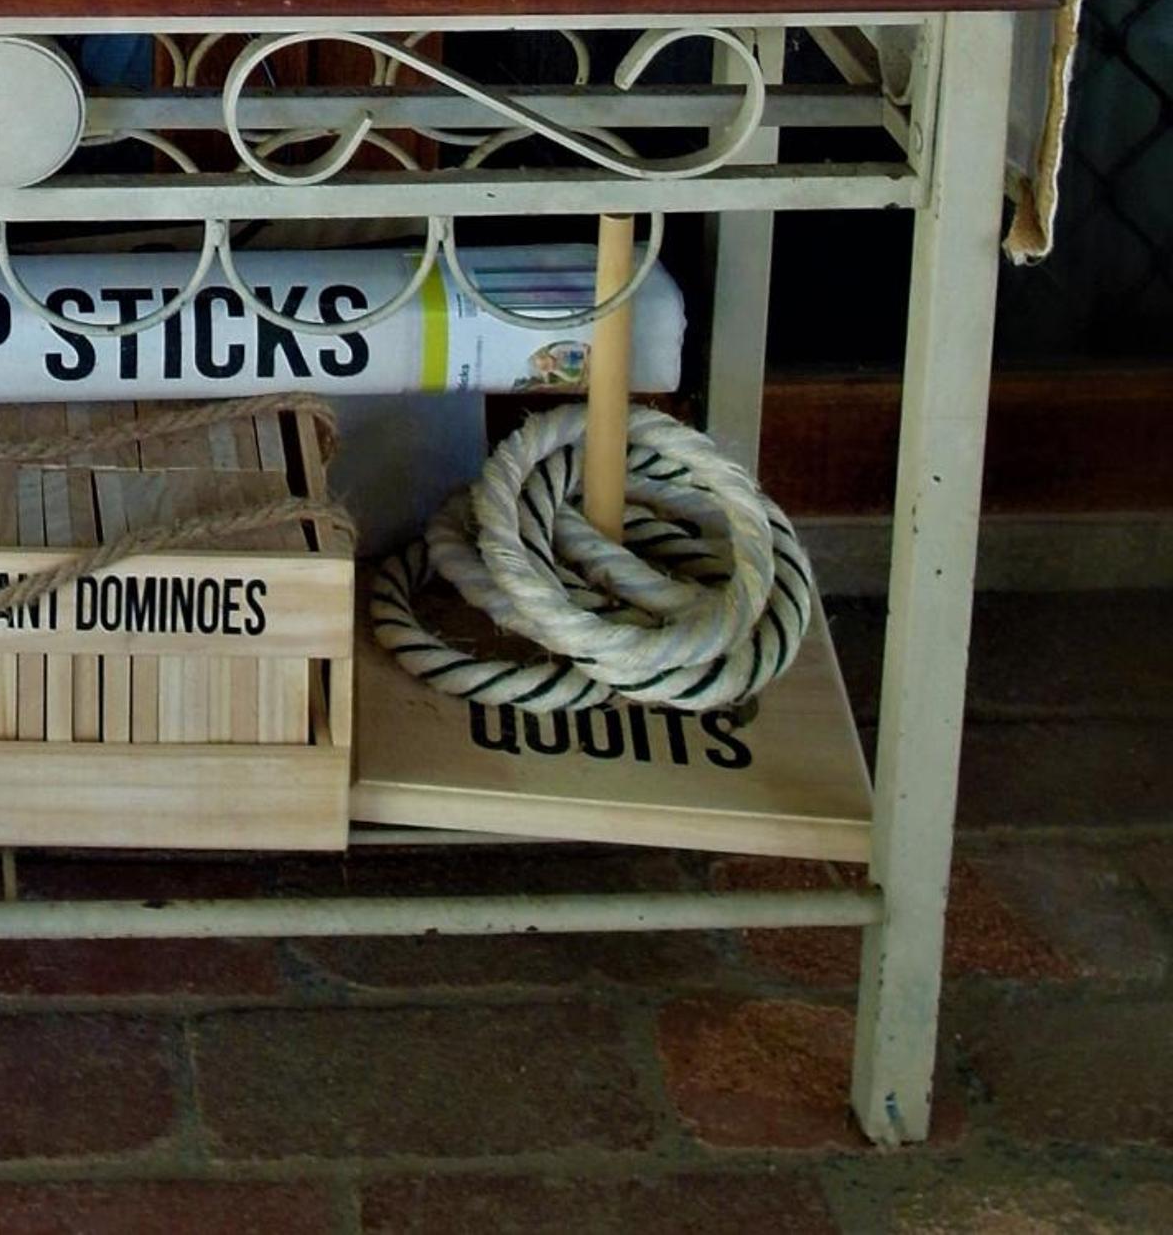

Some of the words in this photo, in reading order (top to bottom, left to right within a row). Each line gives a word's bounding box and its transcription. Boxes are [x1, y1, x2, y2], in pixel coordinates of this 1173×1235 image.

[44, 284, 370, 382] STICKS
[75, 576, 267, 635] DOMINOES
[468, 699, 752, 769] QUOITS
